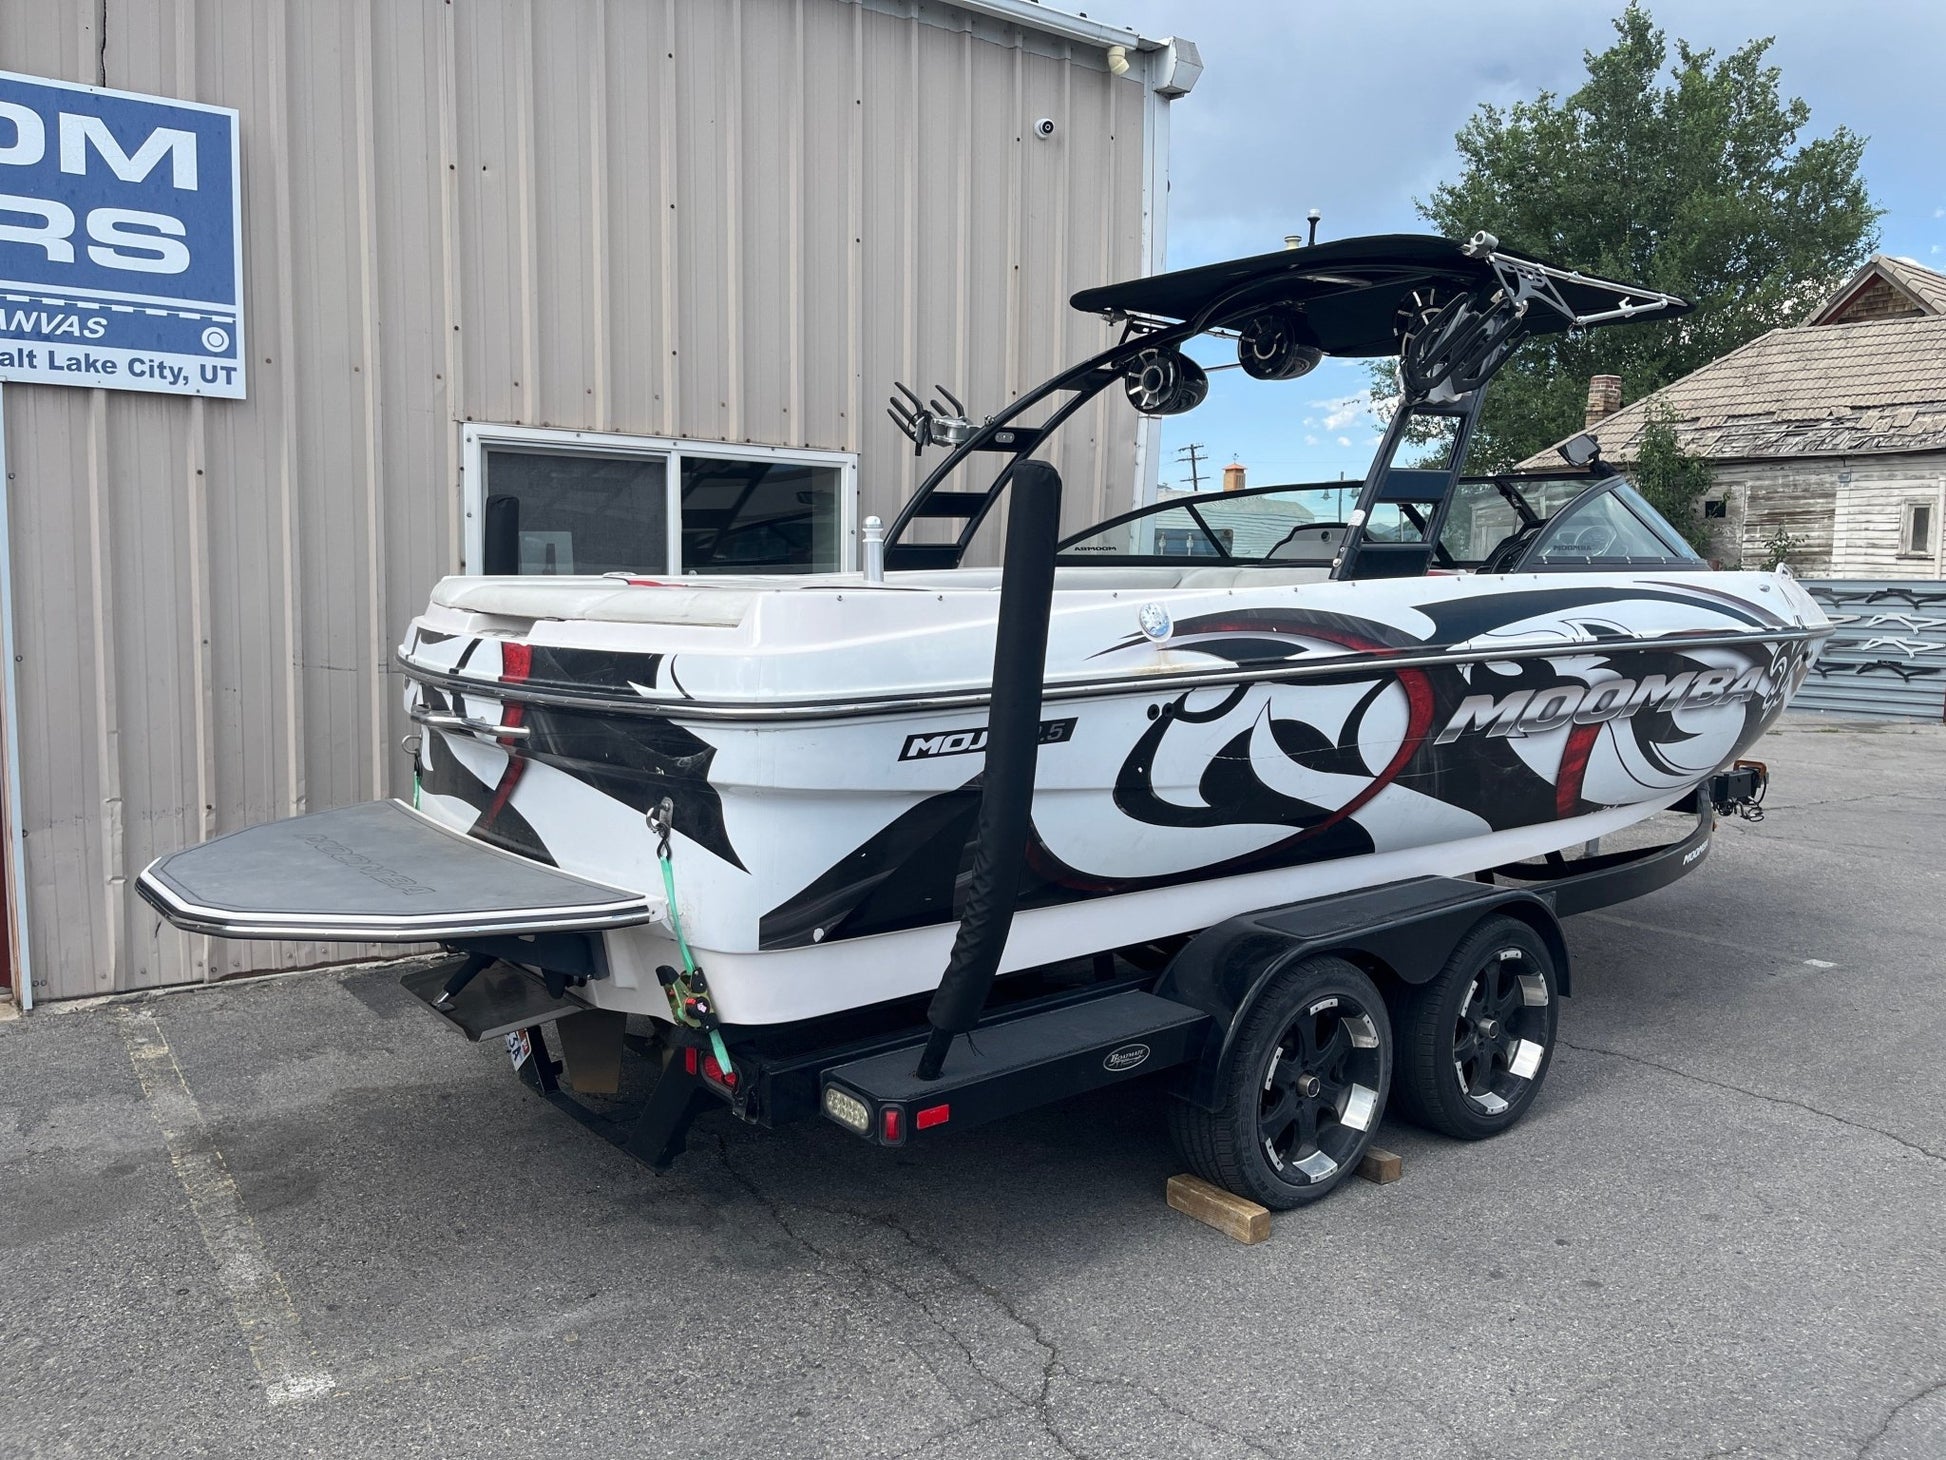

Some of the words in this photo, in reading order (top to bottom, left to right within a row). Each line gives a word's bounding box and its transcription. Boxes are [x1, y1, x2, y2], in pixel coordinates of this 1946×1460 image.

[0, 193, 190, 275] RS
[0, 308, 108, 338] NVAS
[48, 350, 118, 375] Lake
[128, 357, 190, 386] City,
[200, 363, 237, 386] UT
[1434, 666, 1765, 746] MOOMBA
[1039, 722, 1066, 742] .5
